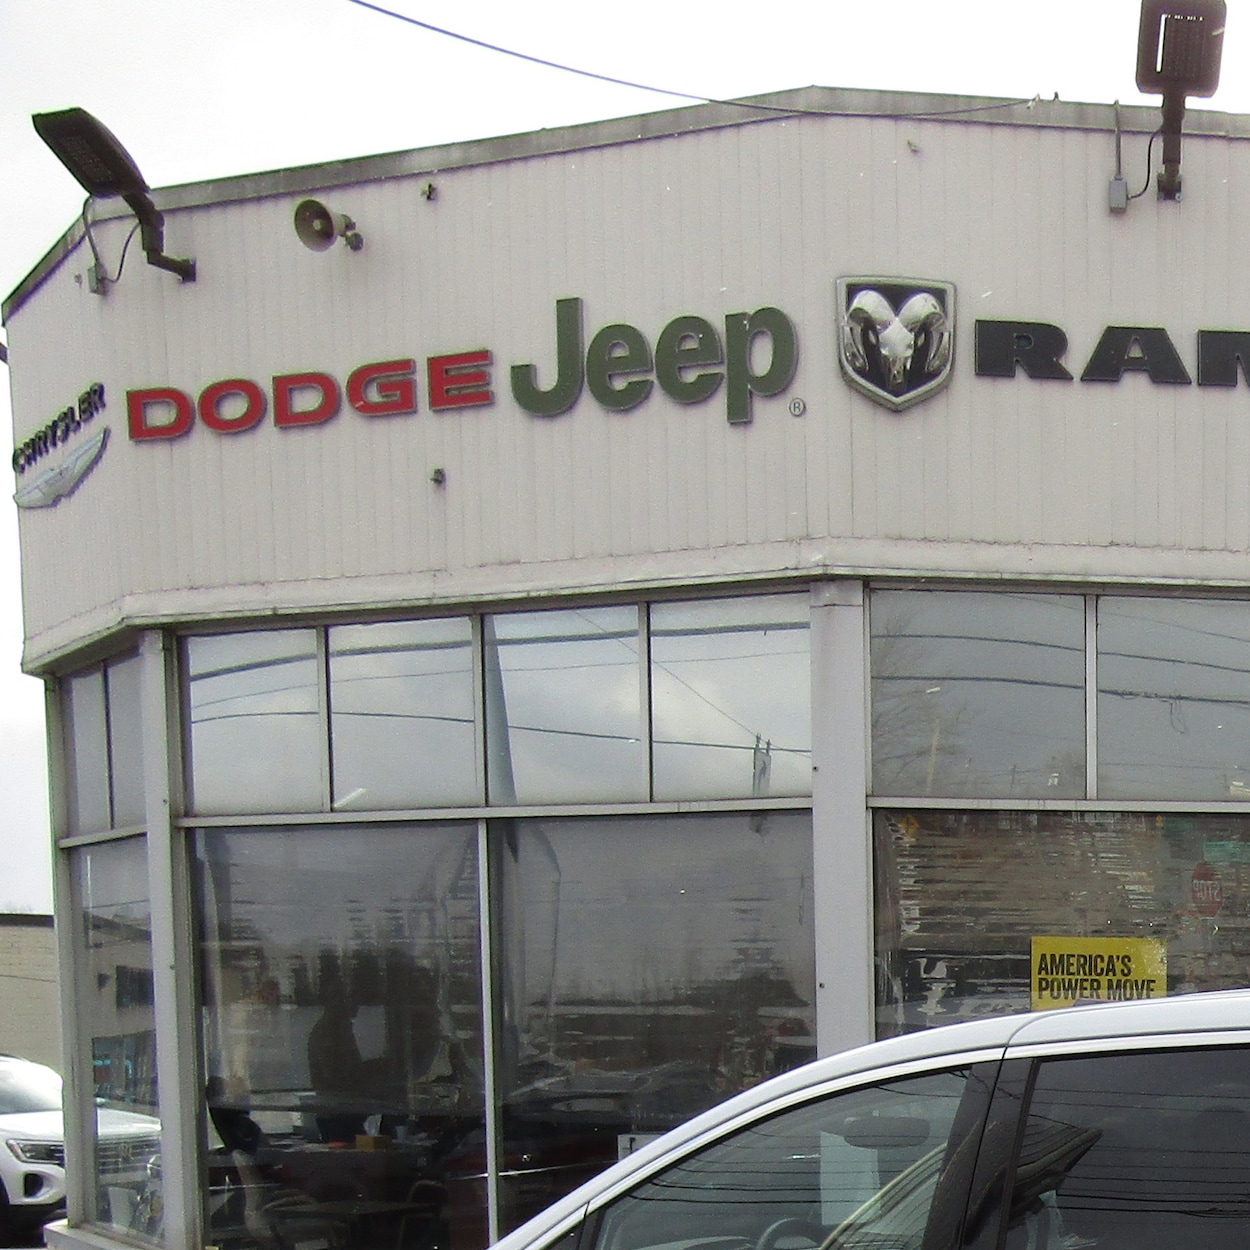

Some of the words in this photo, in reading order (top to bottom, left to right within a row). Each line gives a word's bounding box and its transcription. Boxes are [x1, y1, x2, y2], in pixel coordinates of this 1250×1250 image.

[126, 348, 494, 441] DODGE
[509, 297, 799, 424] Jeep
[12, 382, 106, 474] CHRYSLER
[1037, 953, 1132, 977] AMERICA'S
[1038, 977, 1102, 1000] POWER
